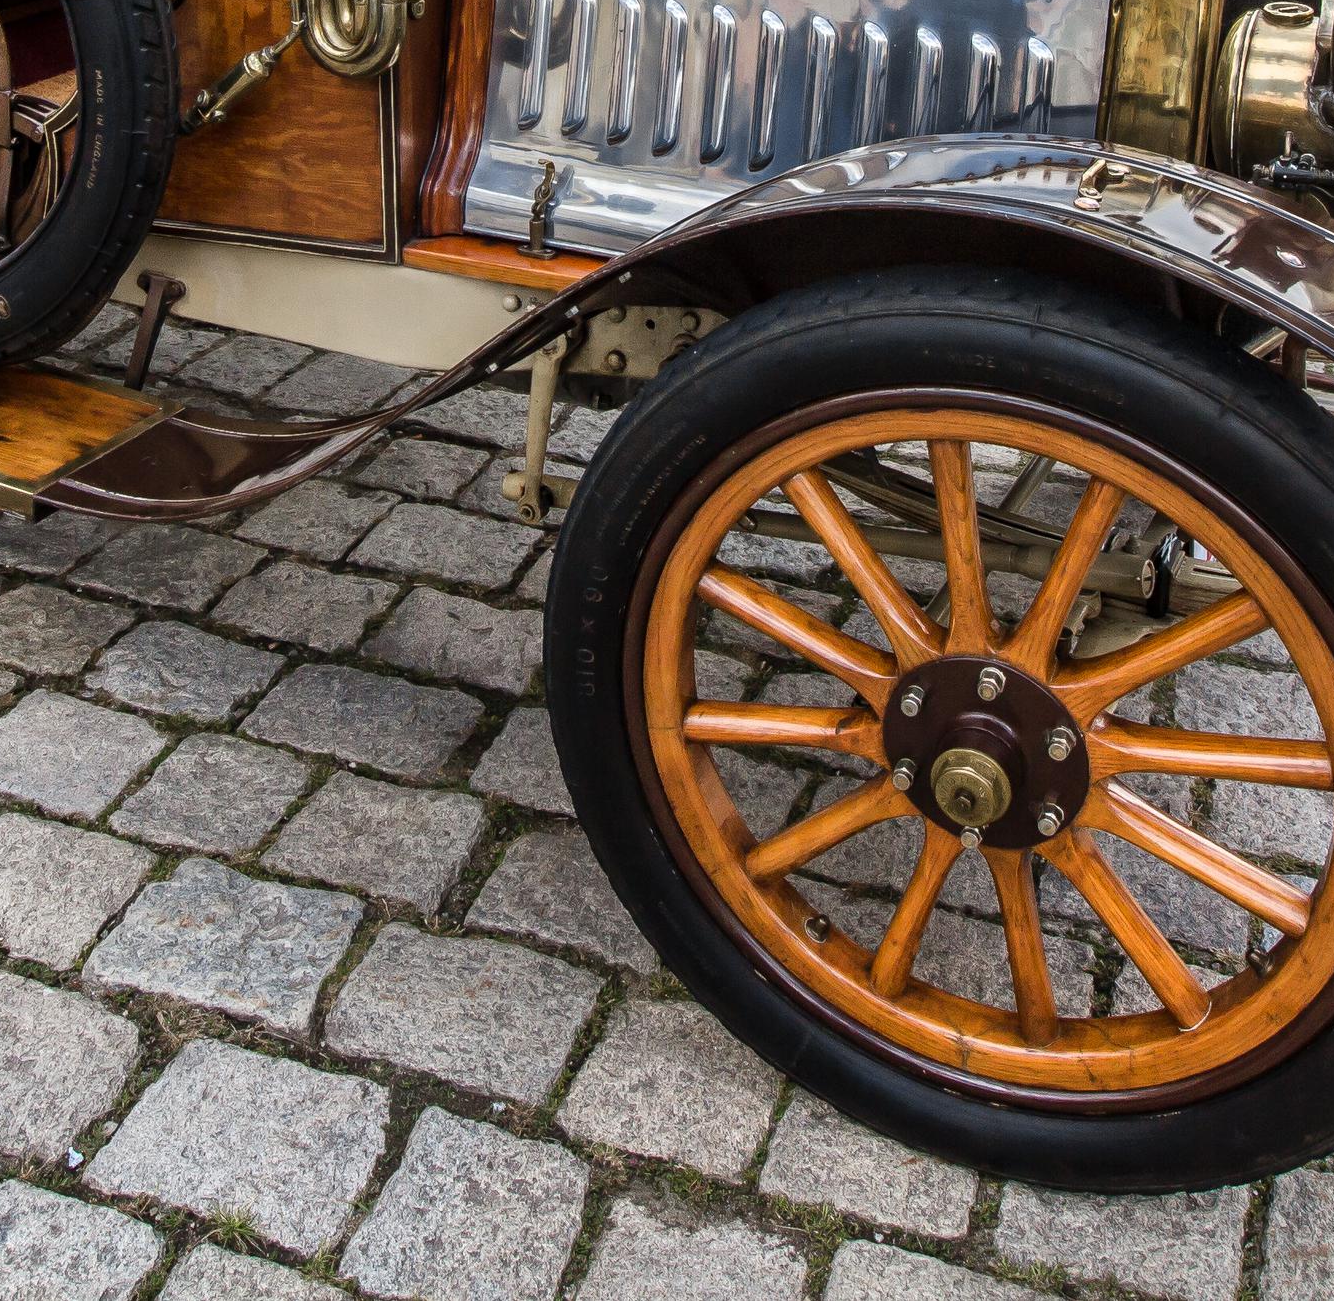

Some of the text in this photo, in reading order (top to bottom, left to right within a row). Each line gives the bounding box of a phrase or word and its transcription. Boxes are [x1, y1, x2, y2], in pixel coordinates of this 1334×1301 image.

[87, 69, 105, 189] MADE IN ENGLAND
